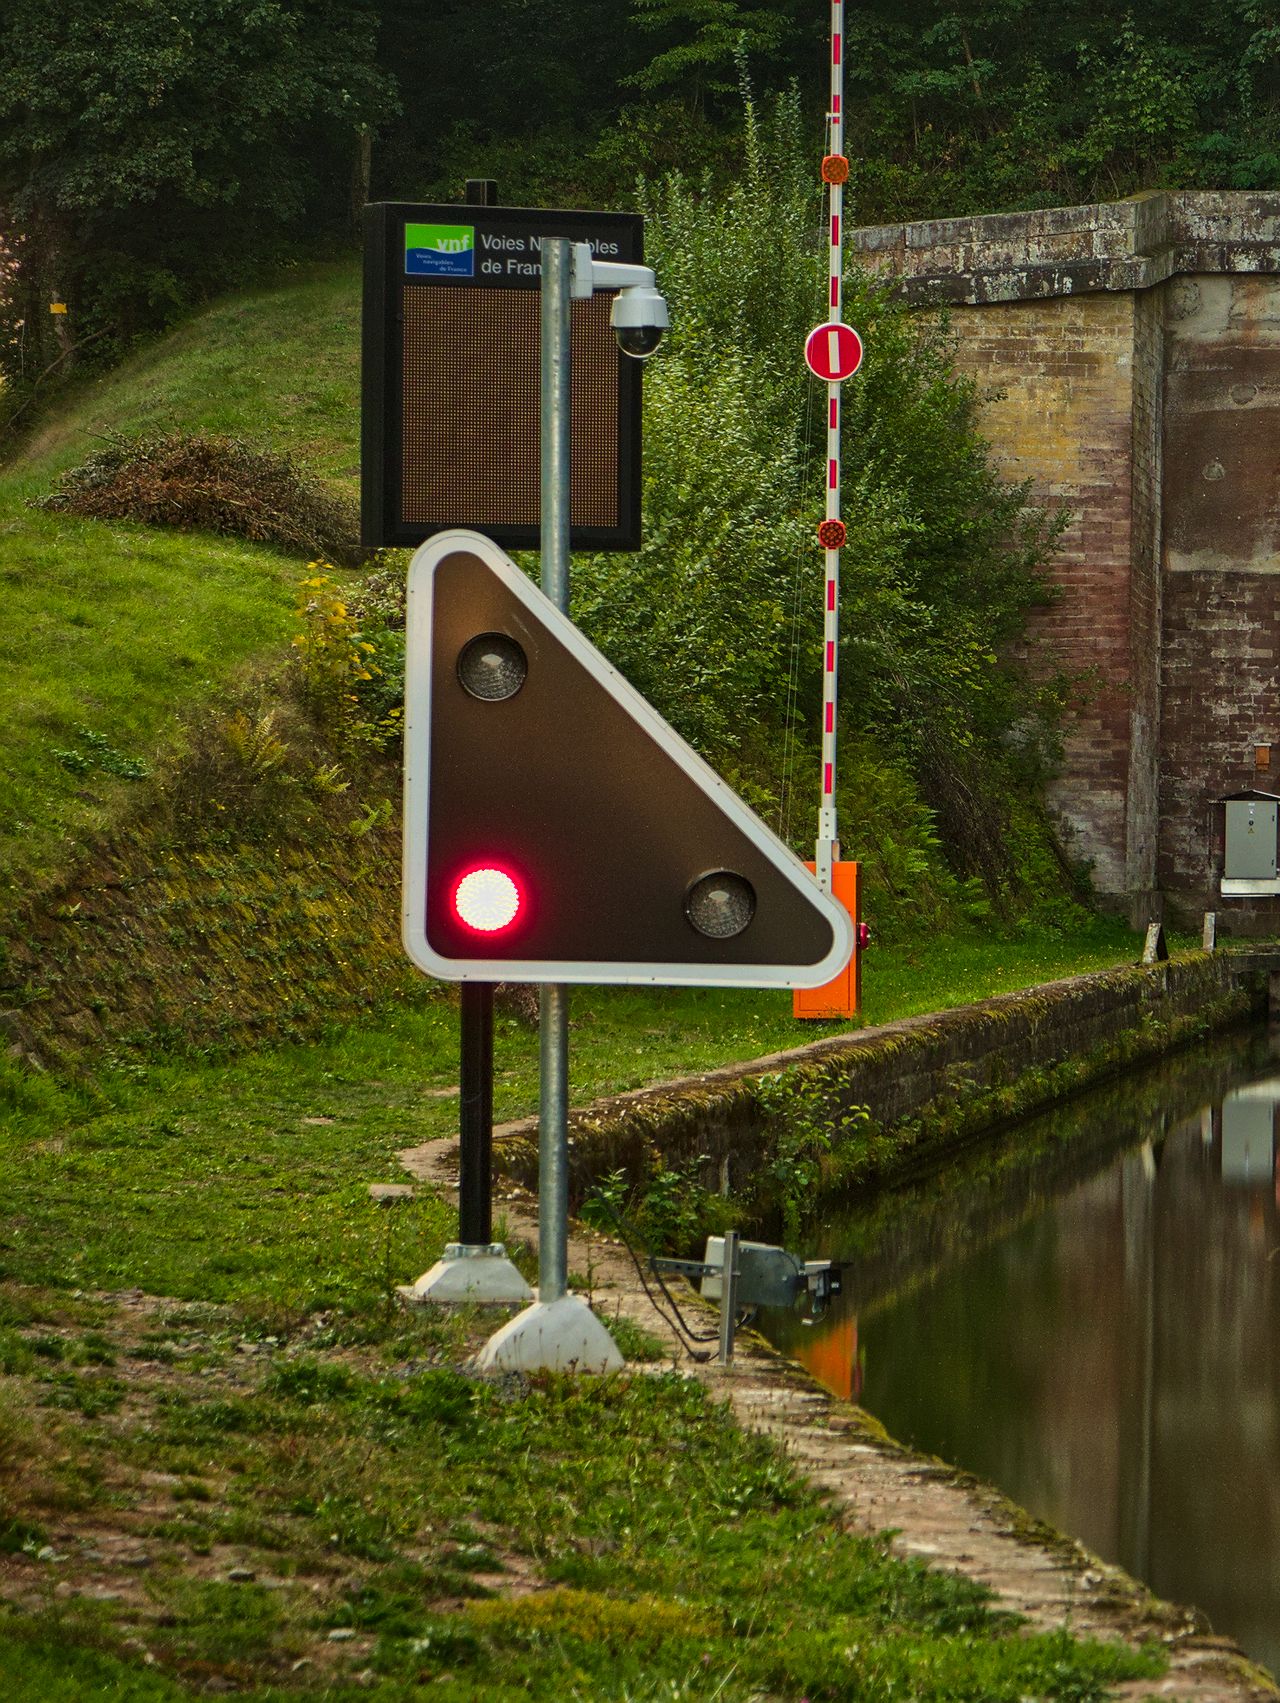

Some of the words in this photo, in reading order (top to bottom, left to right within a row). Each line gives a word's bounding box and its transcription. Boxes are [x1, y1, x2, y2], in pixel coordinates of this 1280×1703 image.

[436, 235, 470, 253] vnf
[481, 234, 525, 251] Voies
[481, 259, 502, 274] de
[507, 260, 542, 275] Fran
